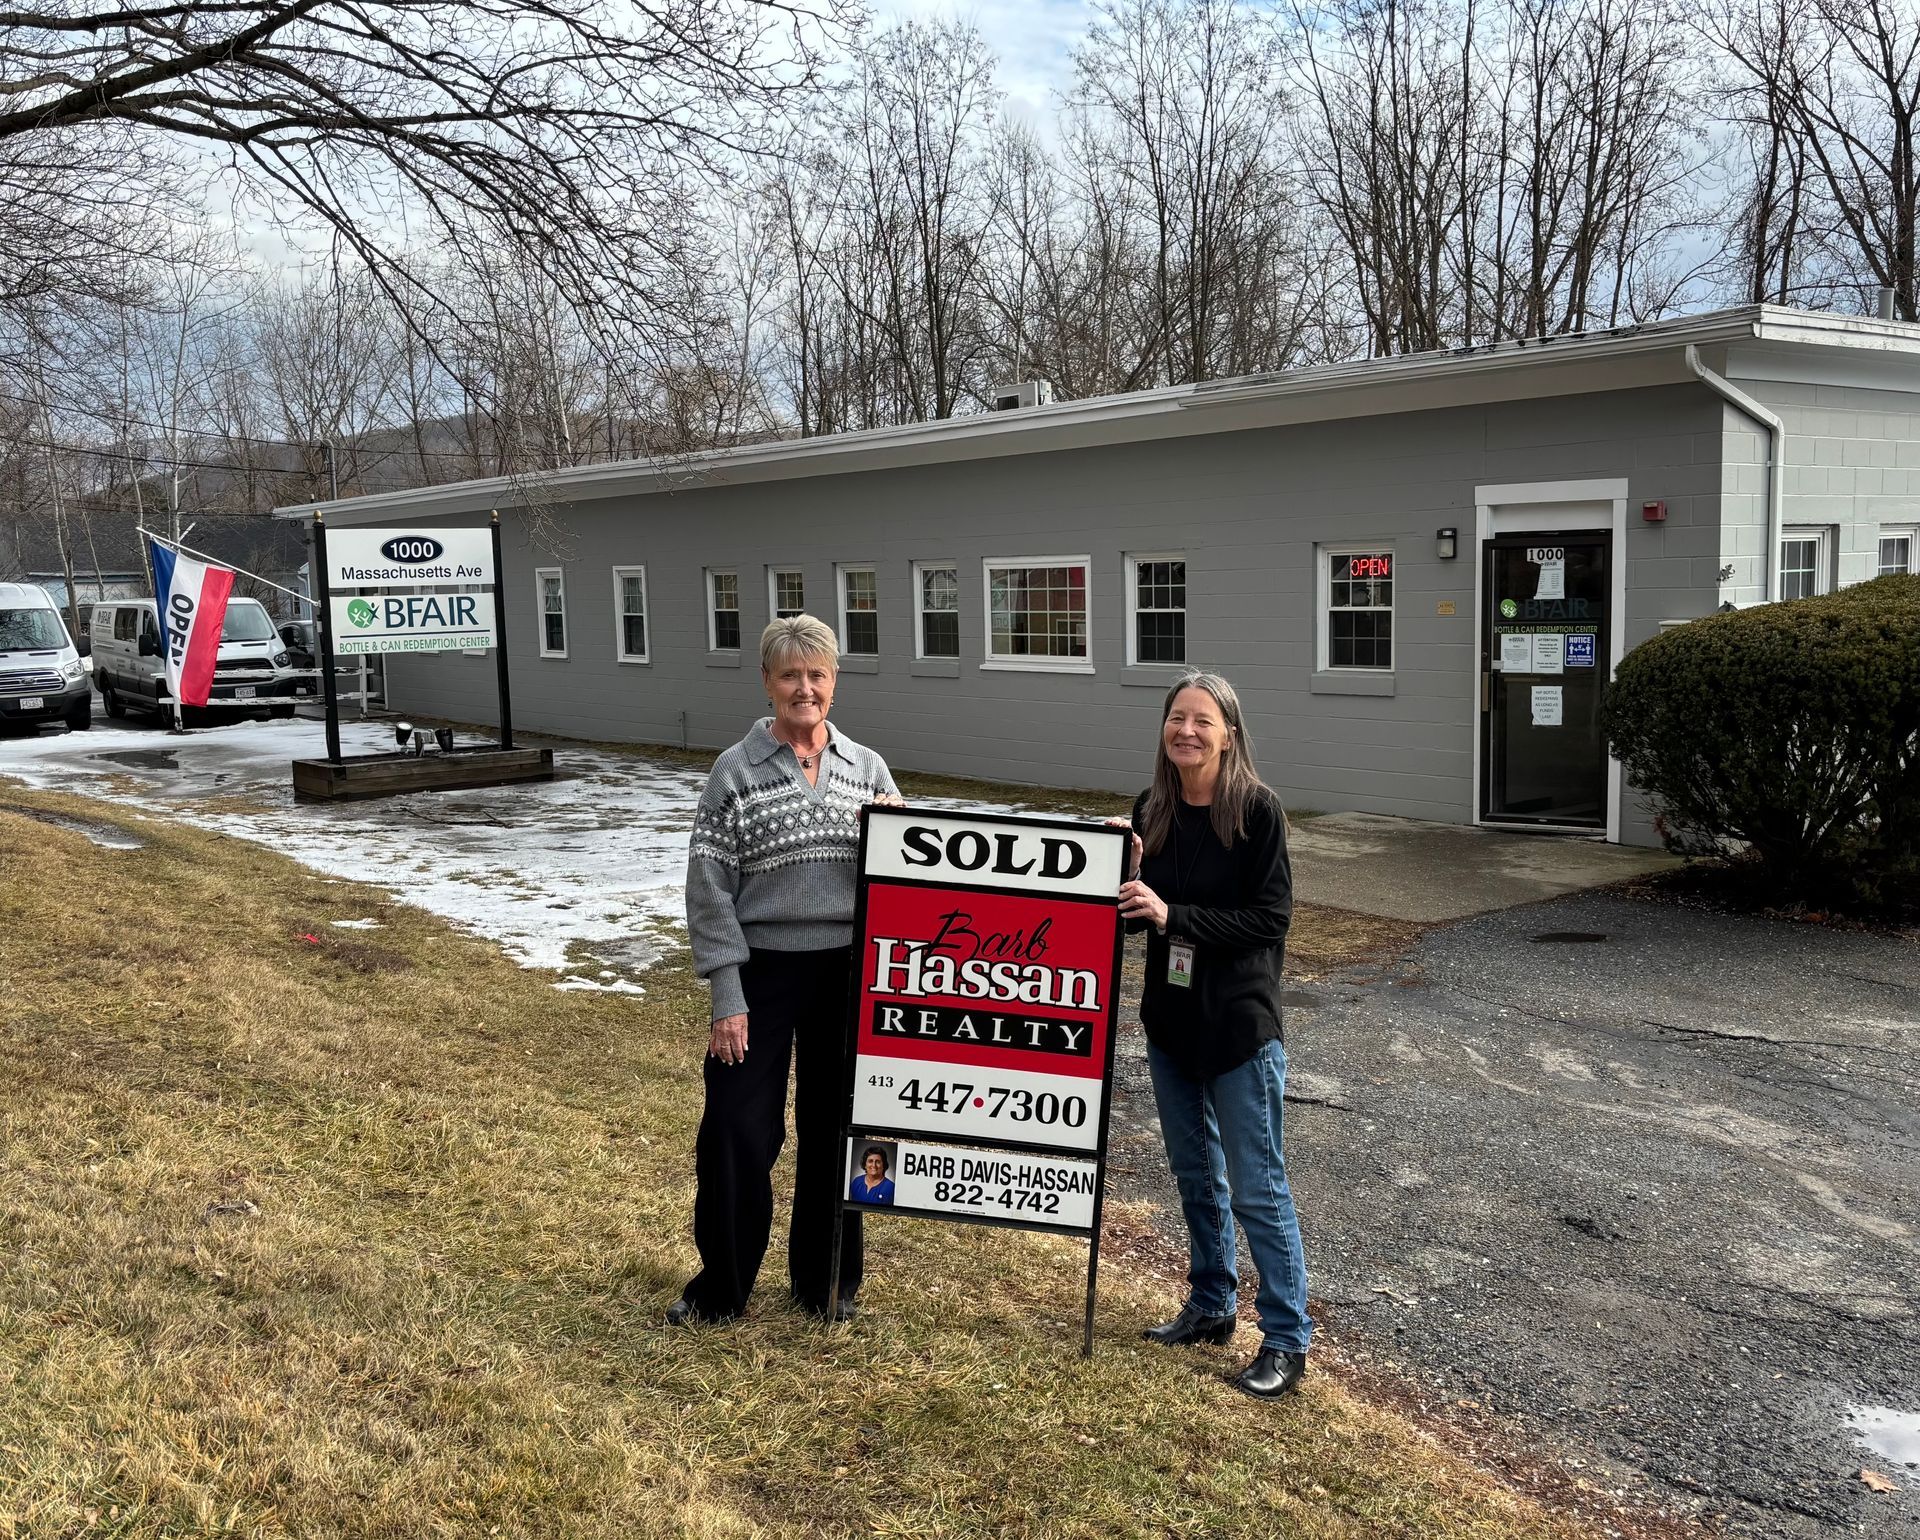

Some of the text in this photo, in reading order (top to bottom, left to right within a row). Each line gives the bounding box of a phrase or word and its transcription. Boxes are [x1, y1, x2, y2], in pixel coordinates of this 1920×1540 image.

[390, 541, 434, 558] 1000
[1529, 548, 1563, 560] 1000
[341, 565, 482, 580] Massachusetts Ave
[1351, 558, 1388, 576] OPEN
[384, 596, 479, 628] BFAIR
[1524, 598, 1590, 619] BFAIR
[1536, 625, 1574, 633] REDEMPTION
[1575, 625, 1598, 633] CENTER
[339, 636, 490, 653] BOTTLE & CAN REDEMPTION CENTER
[1569, 636, 1591, 644] NOTICE
[900, 826, 1087, 879] SOLD
[906, 909, 1053, 961] Barb
[869, 937, 1100, 1011] Hassan
[881, 1007, 1085, 1050] REALTY
[868, 1075, 894, 1088] 413
[904, 1153, 1094, 1195] BARB DAVIS-HASSAN
[934, 1181, 1060, 1214] 822-4742
